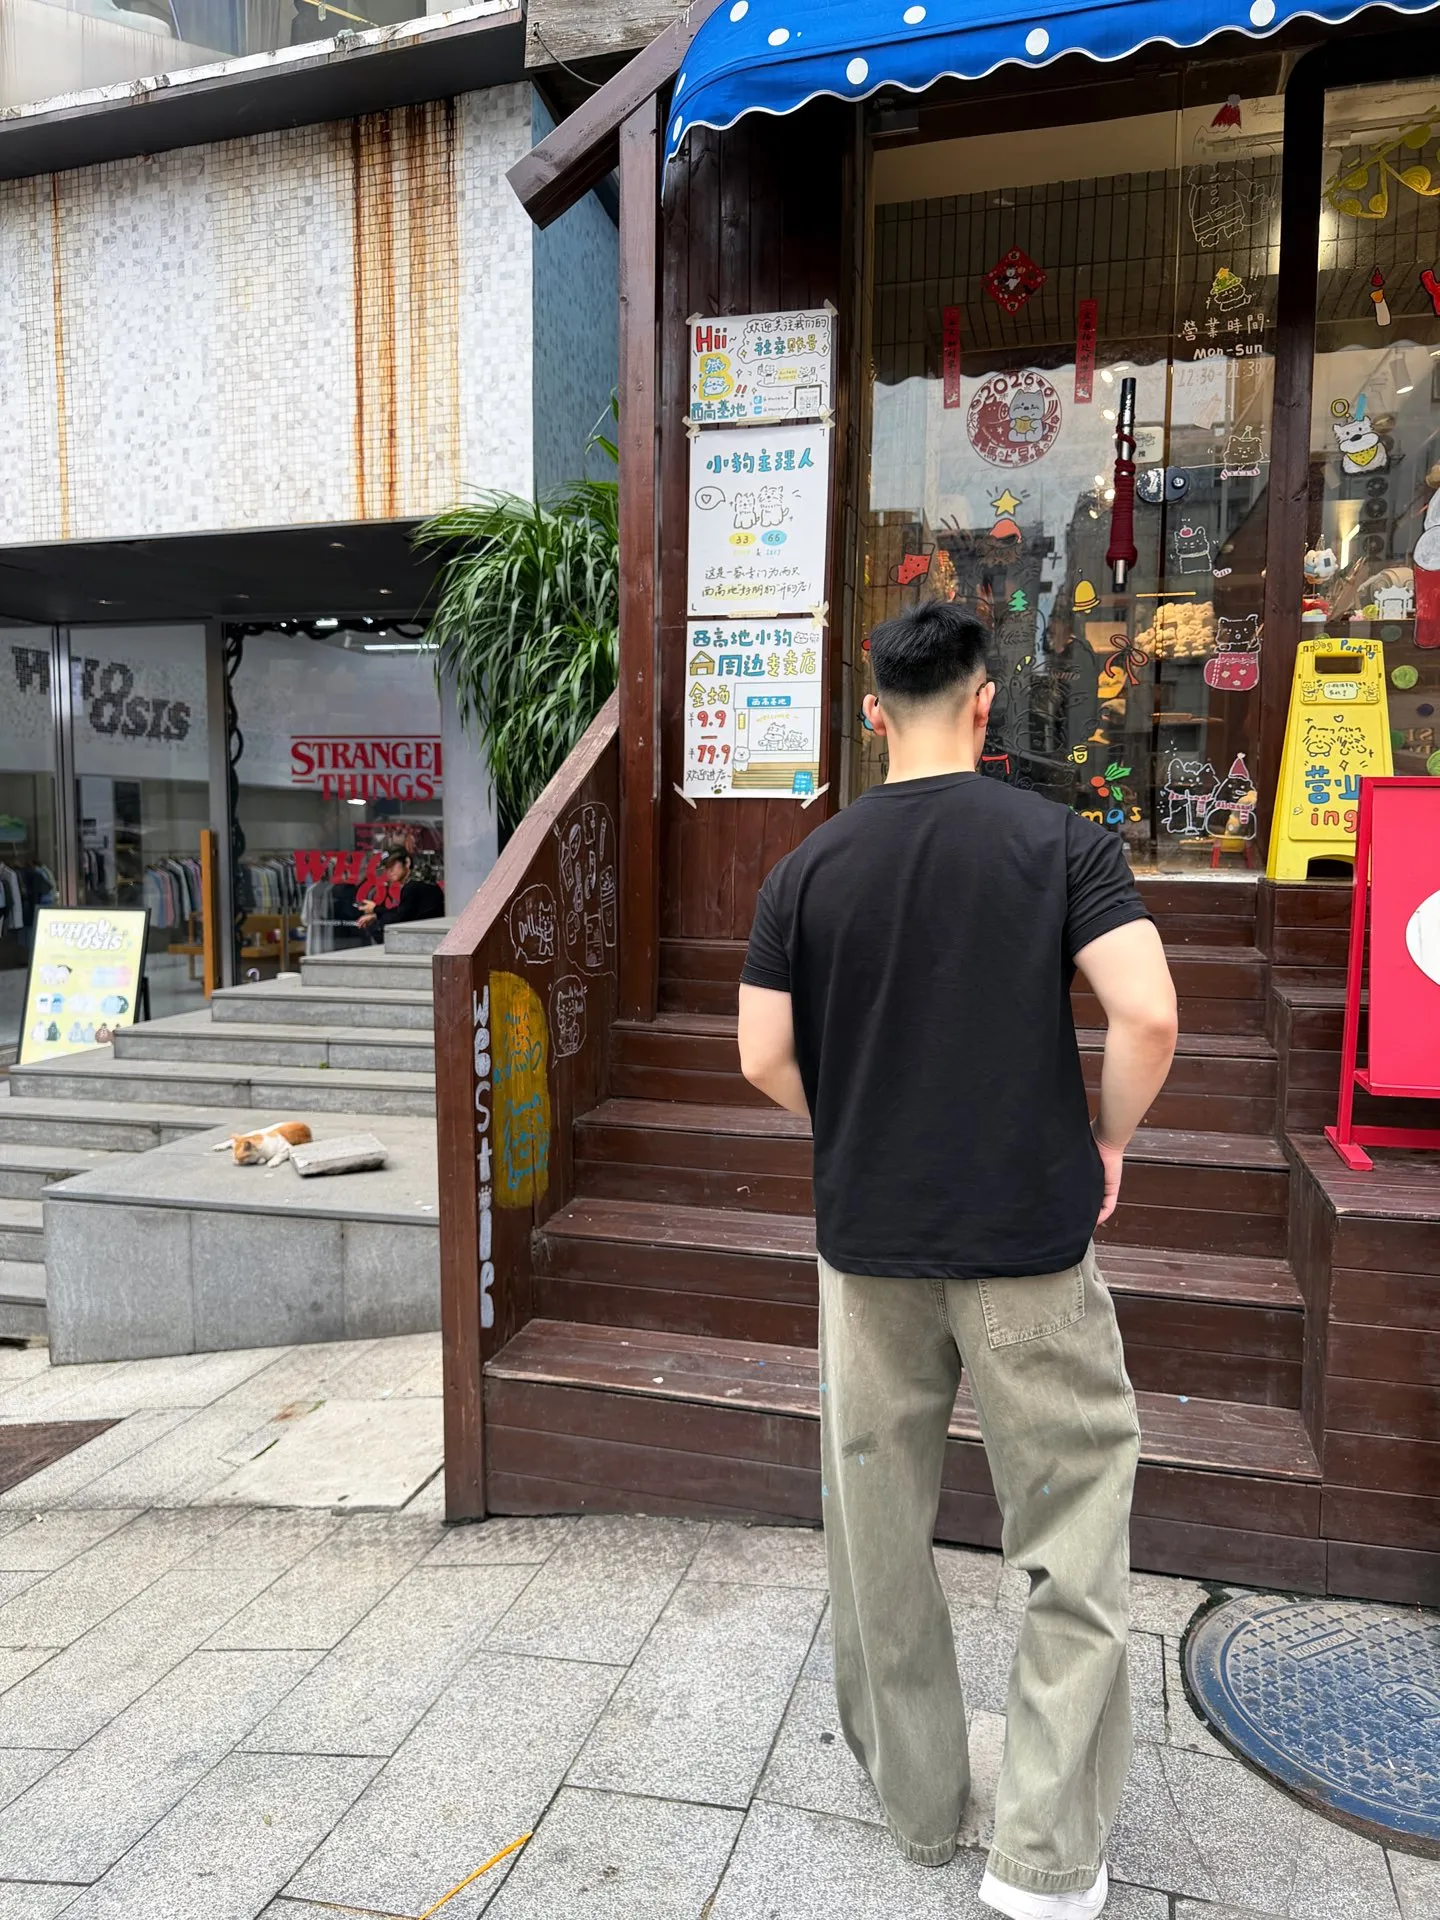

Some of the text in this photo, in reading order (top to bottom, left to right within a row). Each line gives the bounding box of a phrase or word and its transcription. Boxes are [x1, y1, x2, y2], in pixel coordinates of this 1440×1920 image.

[747, 318, 827, 333] 欢迎关注我们的
[1182, 313, 1264, 341] 營業時間
[1193, 344, 1263, 360] Mon-Sun
[980, 372, 1035, 401] 2026
[691, 400, 748, 422] 西高基地
[706, 448, 815, 474] 小狗主理人
[692, 627, 792, 648] 西高地小狗
[717, 649, 816, 677] 周边专卖店
[689, 681, 730, 709] 全场
[90, 697, 192, 741] OSIS
[317, 774, 435, 801] THINGS
[1305, 765, 1361, 804] 营业
[1311, 808, 1359, 833] ing
